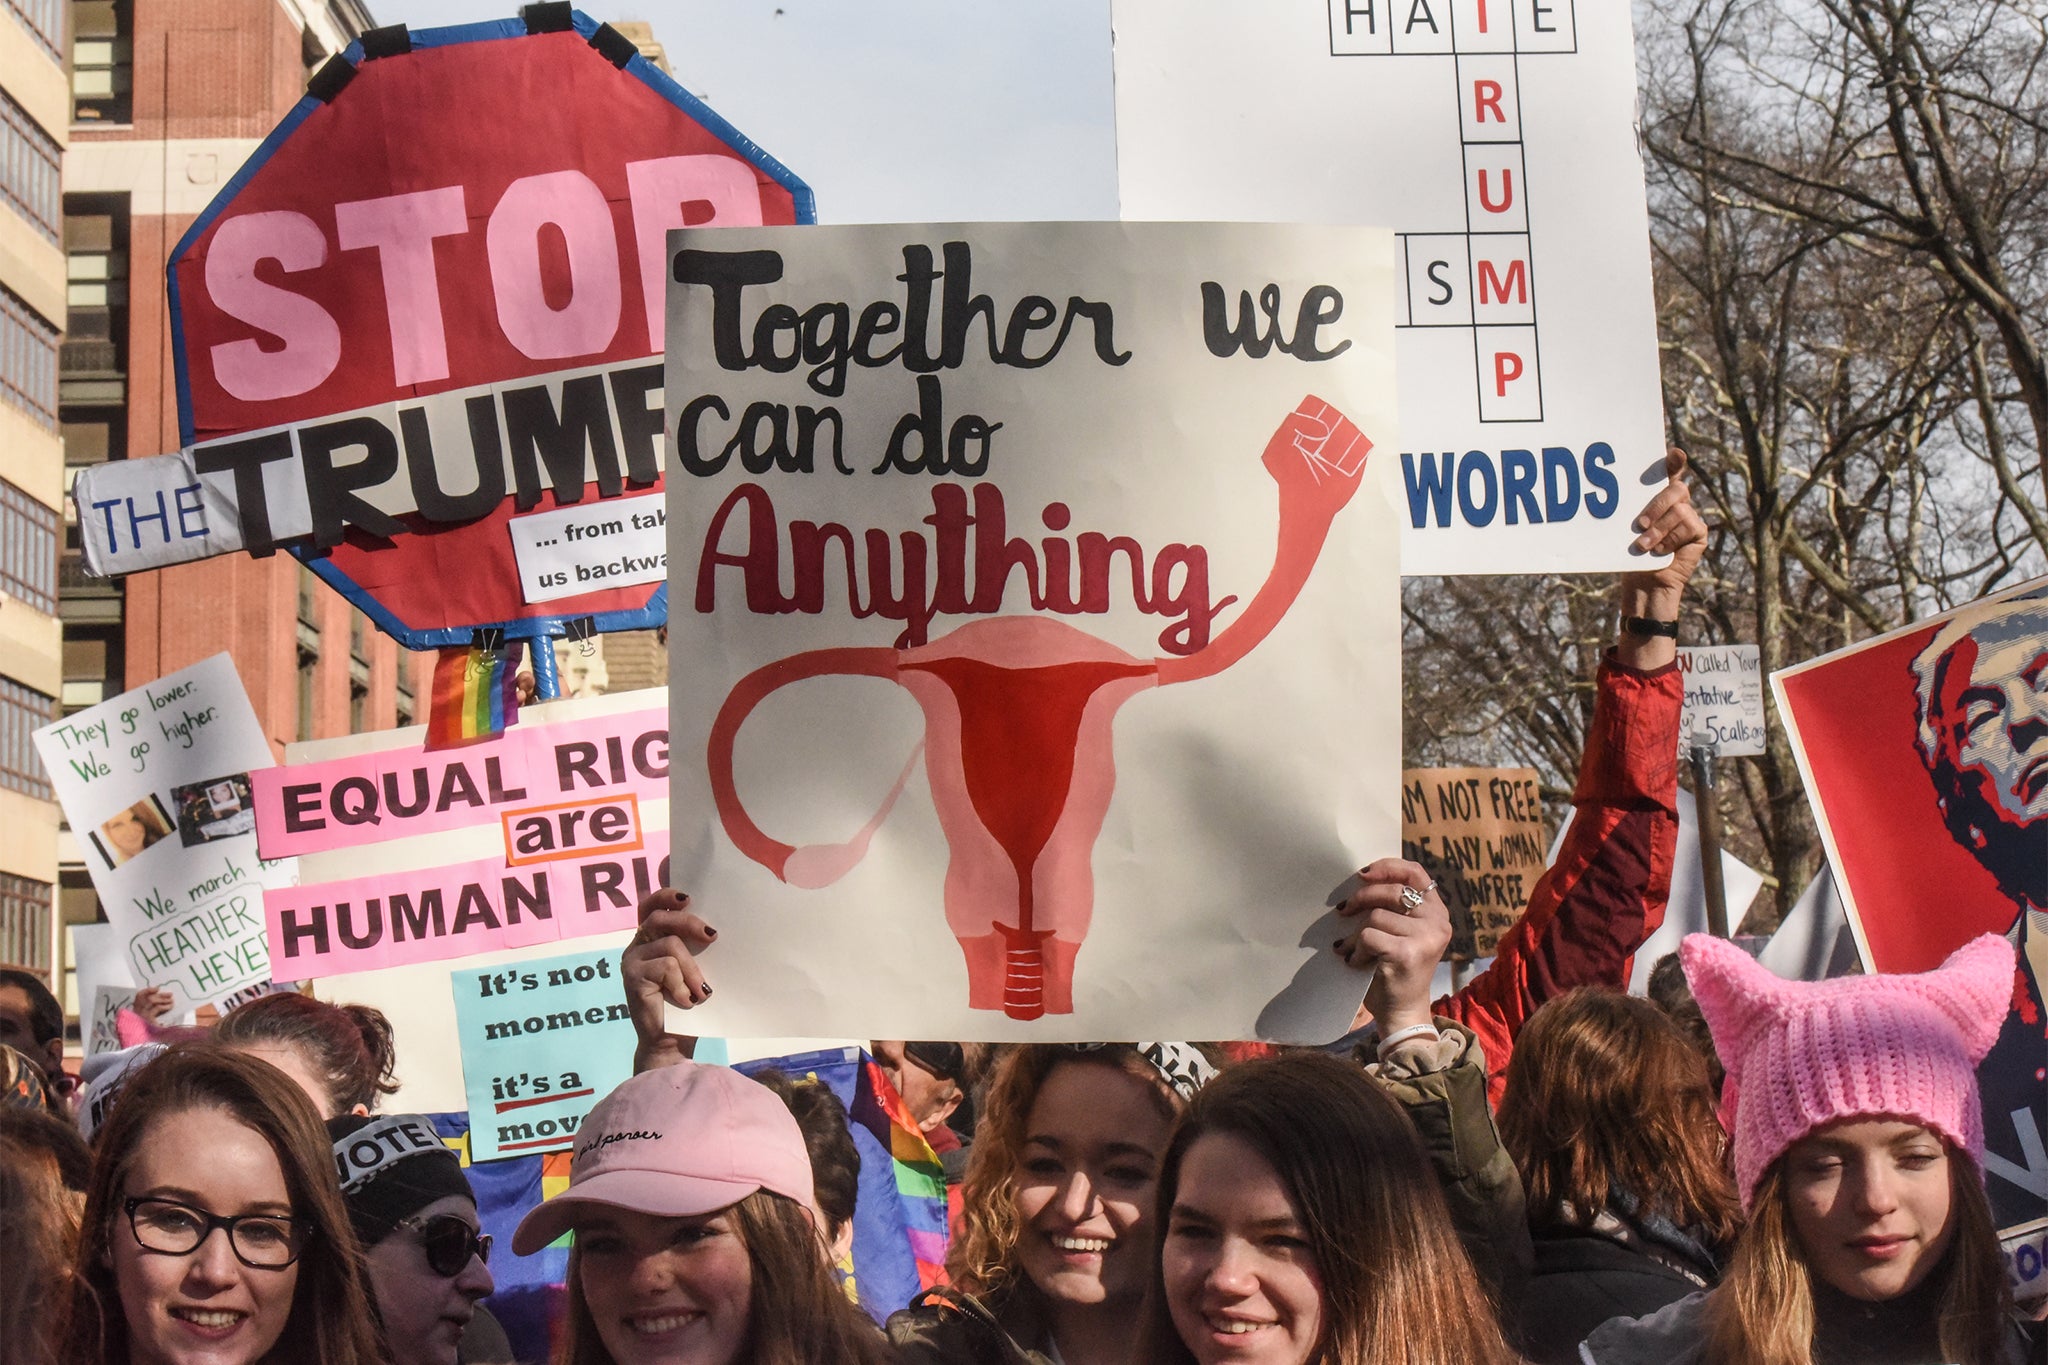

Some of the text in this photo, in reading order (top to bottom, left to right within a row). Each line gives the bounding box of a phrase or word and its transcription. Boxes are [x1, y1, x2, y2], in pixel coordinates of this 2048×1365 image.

[205, 154, 763, 401] STOP
[672, 241, 1353, 397] Together we
[676, 374, 1003, 477] can do
[93, 483, 210, 554] THE
[1401, 441, 1620, 529] WORDS
[565, 519, 623, 542] from
[538, 571, 568, 588] us
[694, 482, 1239, 655] Anything
[50, 680, 198, 749] They go lower.
[69, 706, 219, 783] We go higher.
[282, 730, 669, 834] EQUAL RIG
[1437, 779, 1481, 823] NOT
[1488, 776, 1539, 823] FREE
[515, 805, 630, 854] are
[1442, 835, 1480, 871] ANY
[1486, 830, 1543, 869] WOMAN
[132, 887, 177, 921] We
[188, 856, 247, 902] march
[280, 871, 552, 959] HUMAN
[1455, 873, 1528, 910] UNFREE
[137, 896, 260, 974] HEATHER
[547, 957, 611, 987] not
[485, 1002, 631, 1041] momen
[559, 1071, 583, 1090] a
[497, 1114, 588, 1142] mov
